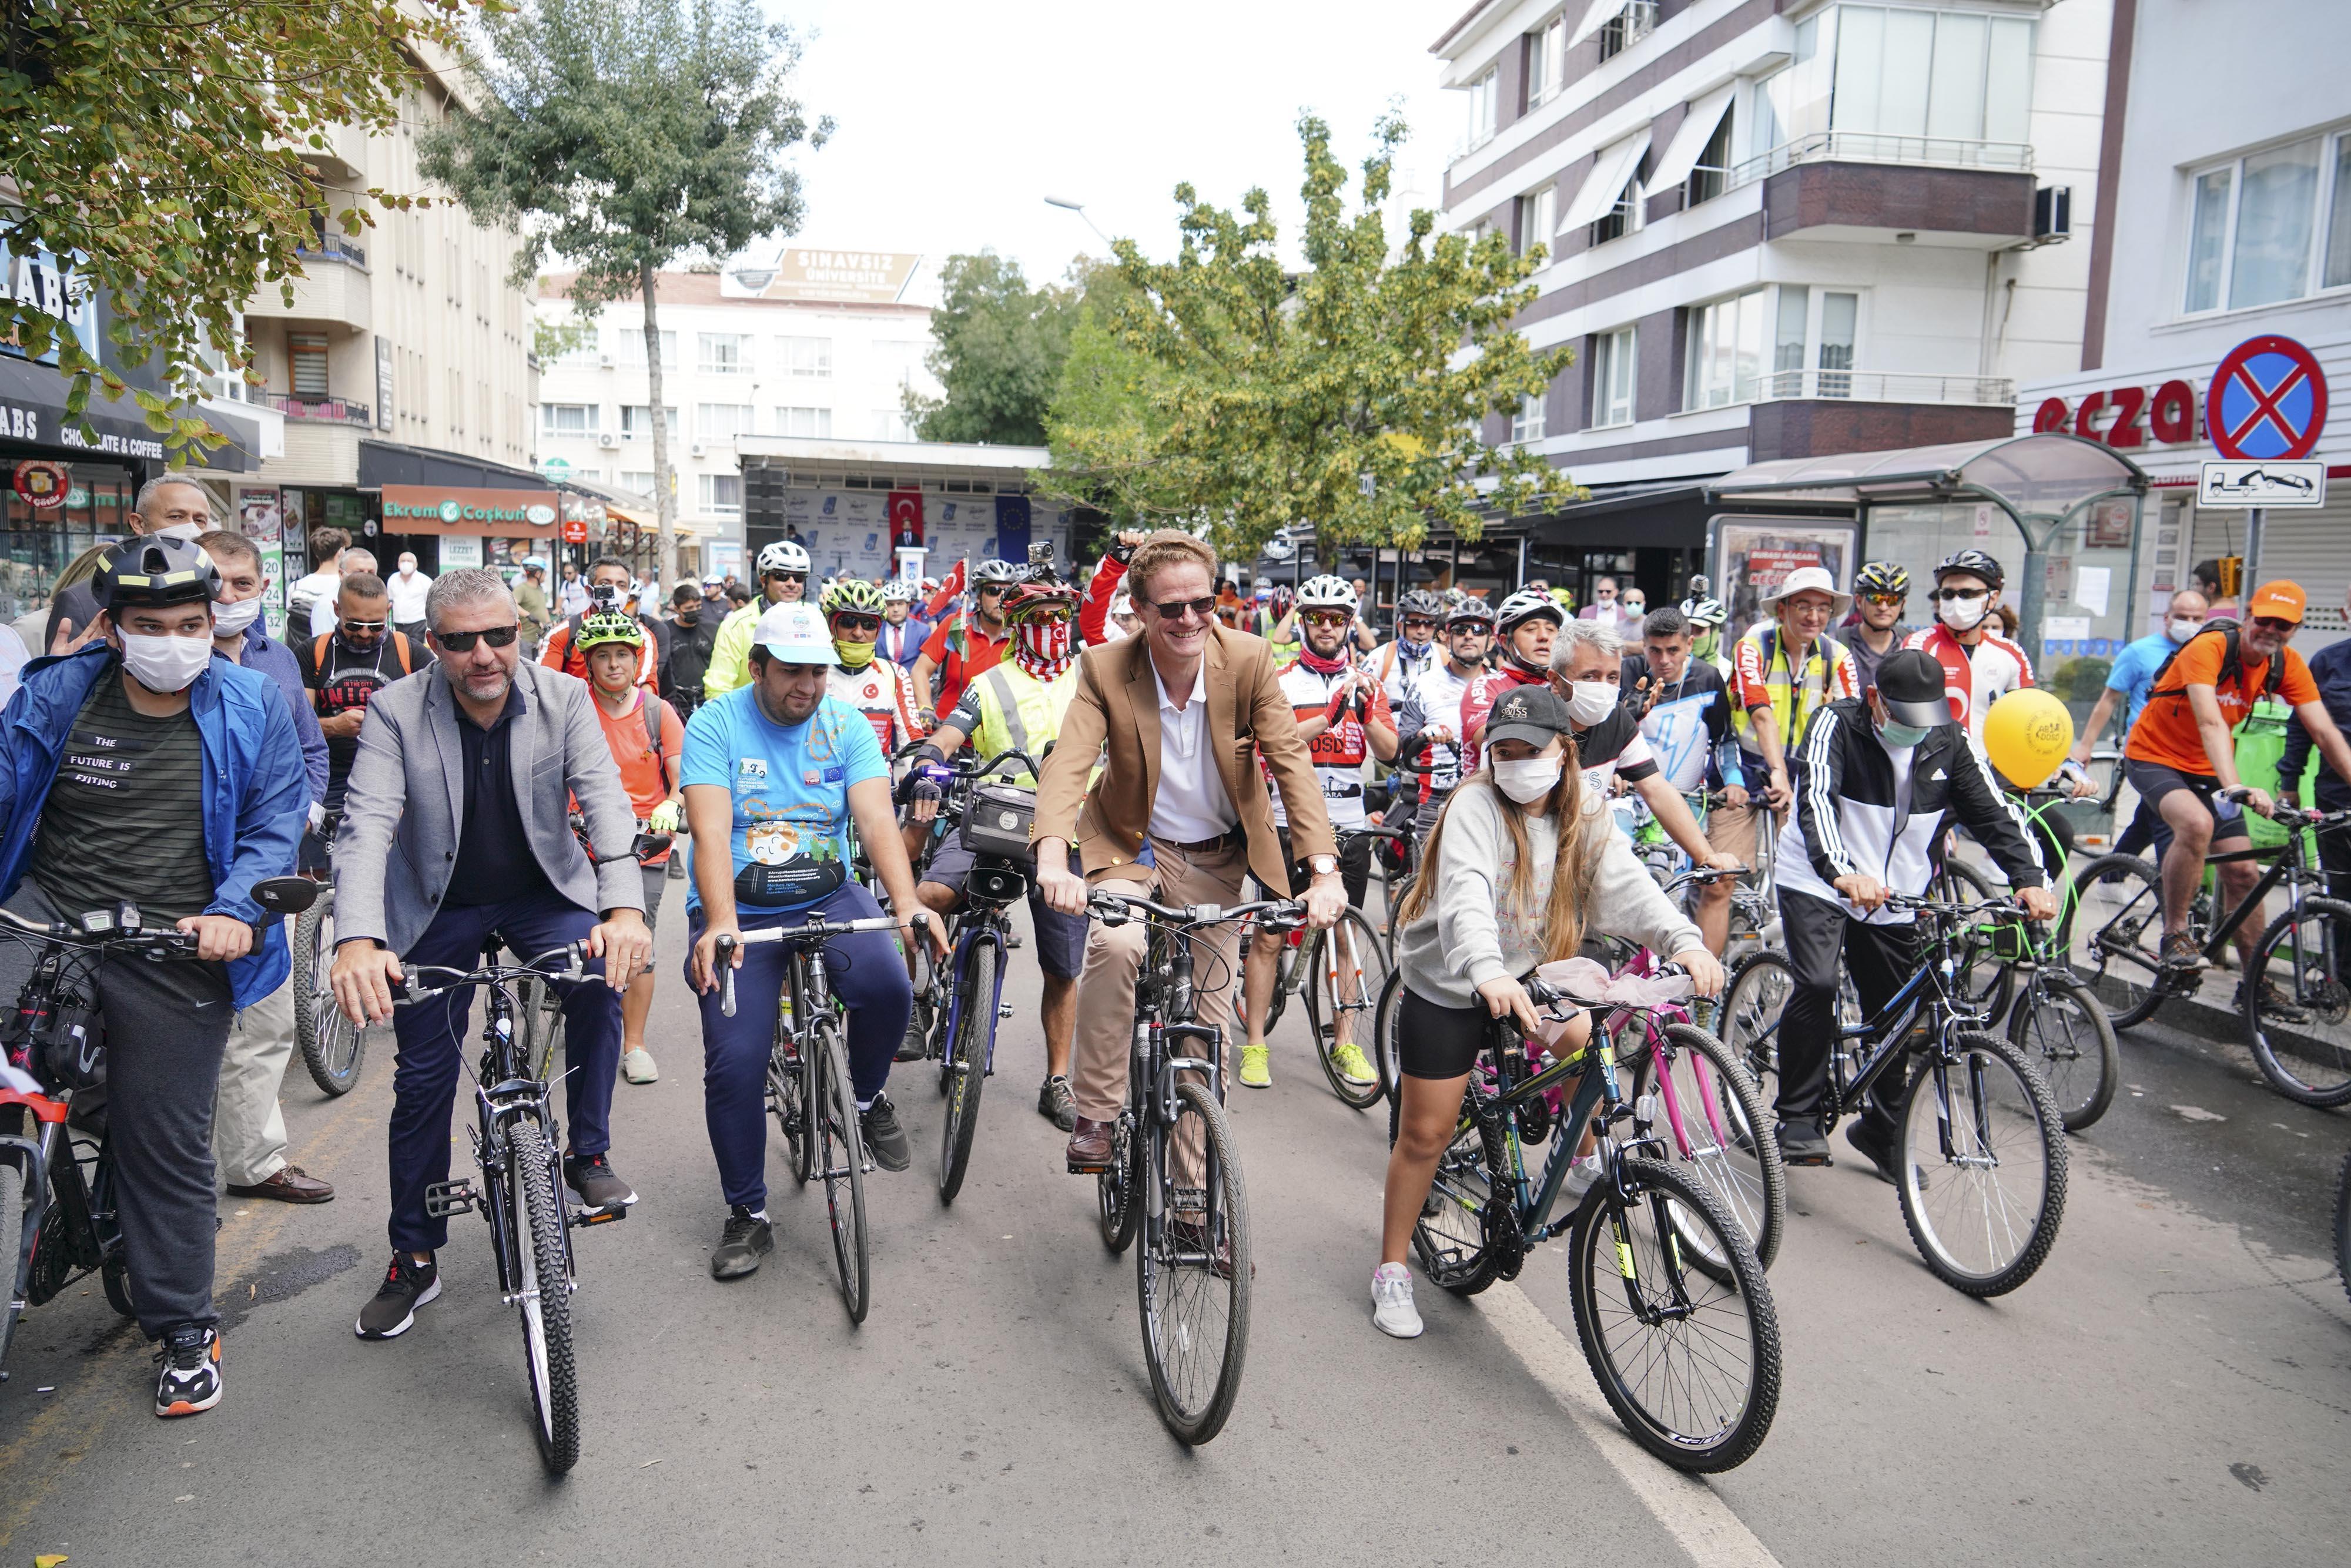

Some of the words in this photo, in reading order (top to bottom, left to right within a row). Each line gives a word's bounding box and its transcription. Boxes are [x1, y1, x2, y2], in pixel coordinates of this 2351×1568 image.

[0, 257, 83, 327] ABS
[2032, 379, 2208, 447] ecza
[61, 427, 119, 453] CHOLATE
[121, 437, 128, 454] &
[130, 439, 162, 458] COFFEE
[383, 501, 437, 518] Ekrem
[463, 504, 527, 524] Coşkun
[449, 546, 474, 554] LEZZET
[265, 562, 278, 573] 20
[266, 589, 279, 600] 24
[267, 616, 281, 627] 32
[1501, 707, 1527, 718] SWISS
[95, 736, 117, 747] THE
[1308, 736, 1344, 753] OSD
[71, 756, 113, 769] FUTURE
[119, 762, 131, 770] IS
